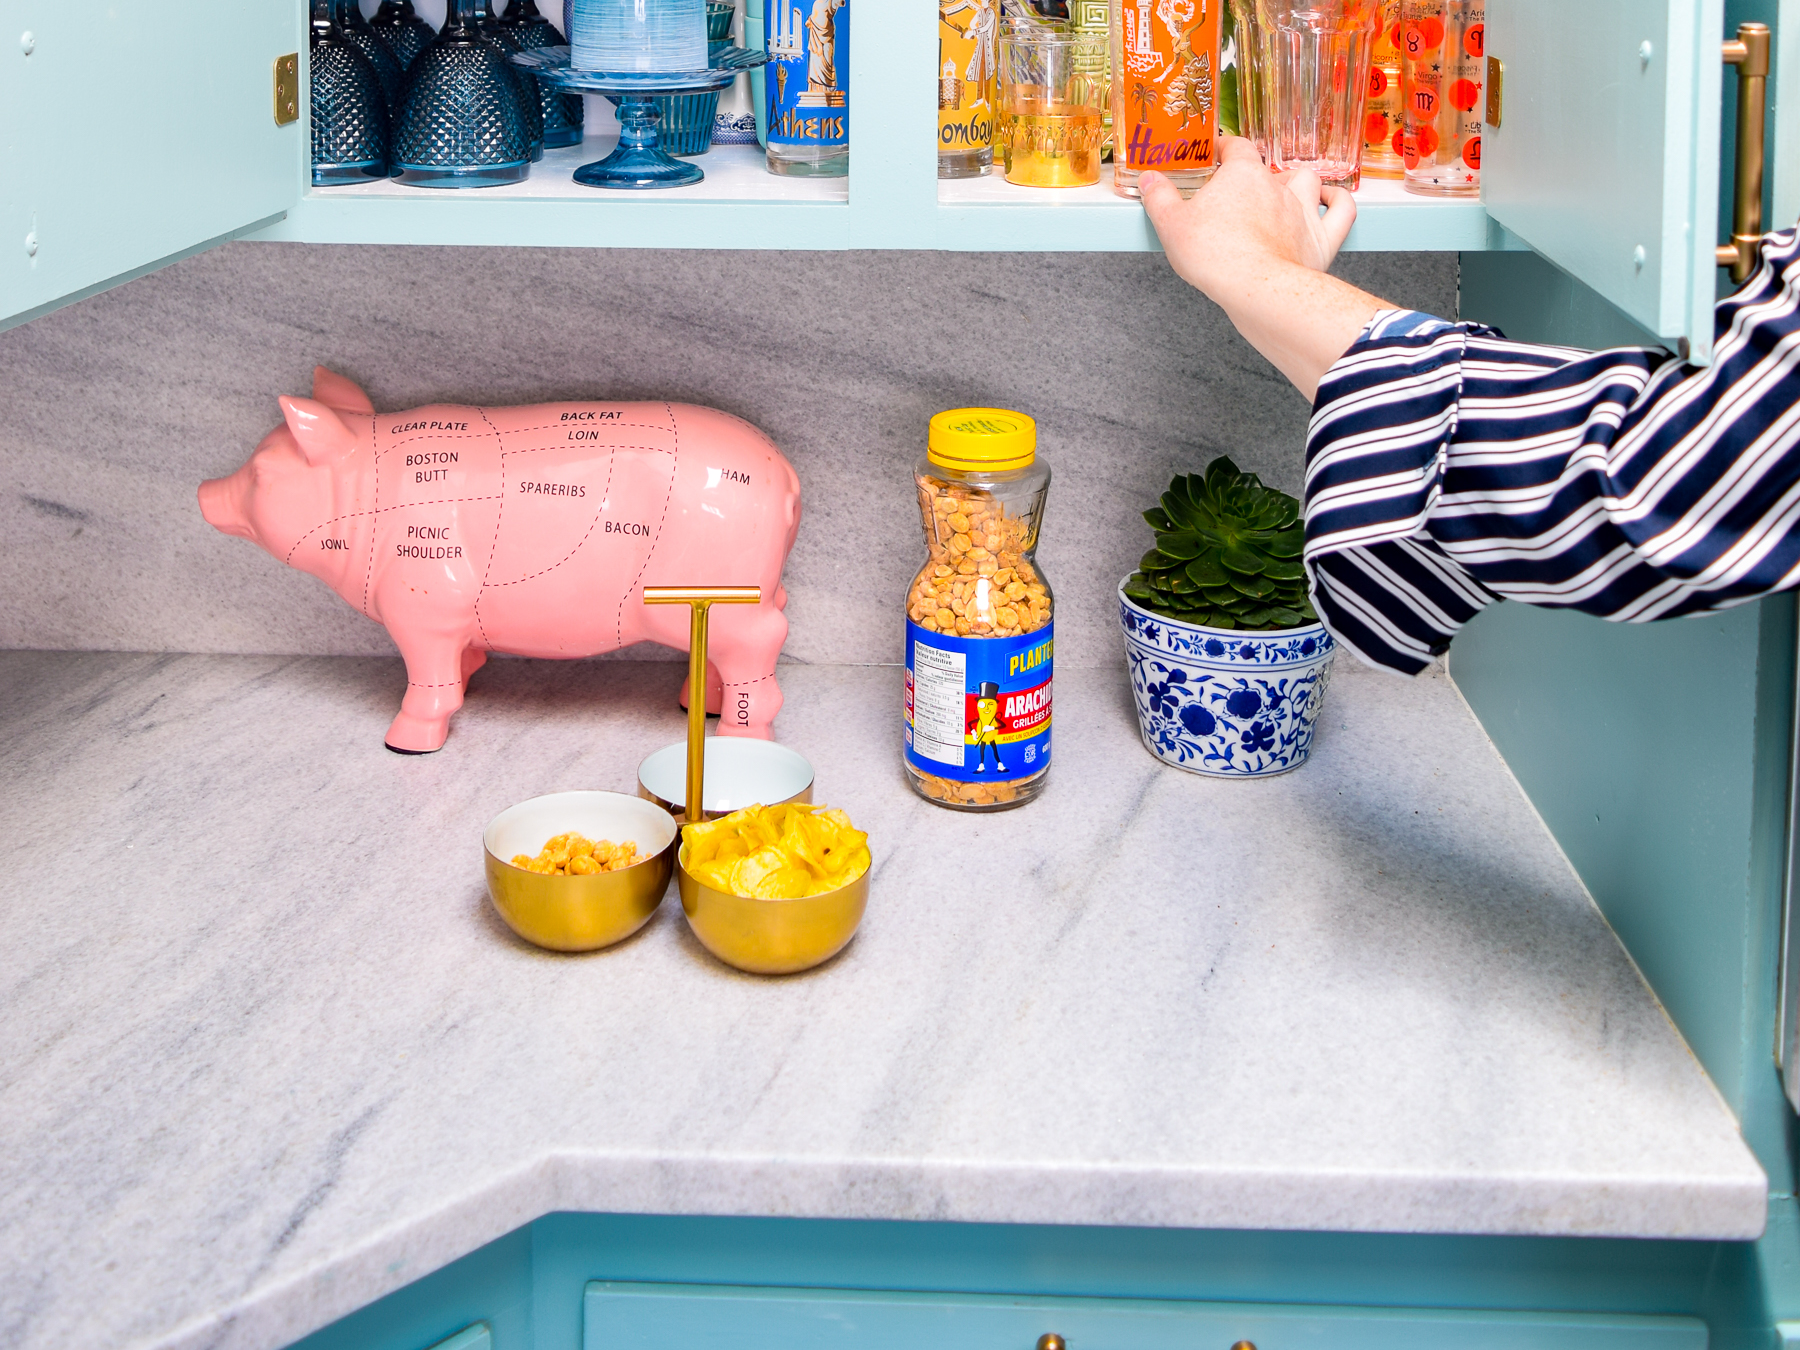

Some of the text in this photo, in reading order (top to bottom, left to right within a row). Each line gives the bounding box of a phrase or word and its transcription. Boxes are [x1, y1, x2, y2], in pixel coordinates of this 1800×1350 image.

[1418, 71, 1438, 81] Virgo
[768, 94, 844, 140] Athens
[938, 113, 993, 146] ombay
[1127, 123, 1212, 166] Havana
[561, 410, 624, 421] BACK FAT
[391, 420, 468, 435] CLEAR PLATE
[568, 430, 600, 440] LOIN
[405, 451, 459, 467] BOSTON
[415, 468, 449, 484] BUTT
[720, 467, 751, 486] HAM
[519, 481, 586, 498] SPARERIBS
[407, 525, 450, 540] PICNIC
[604, 520, 650, 538] BACON
[320, 538, 350, 551] JOWL
[396, 544, 463, 560] SHOULDER
[930, 653, 953, 666] nutritive
[935, 649, 951, 659] Facts
[737, 692, 749, 728] FOOT
[1013, 709, 1045, 729] GRILLÉES
[1002, 733, 1015, 742] AVEC
